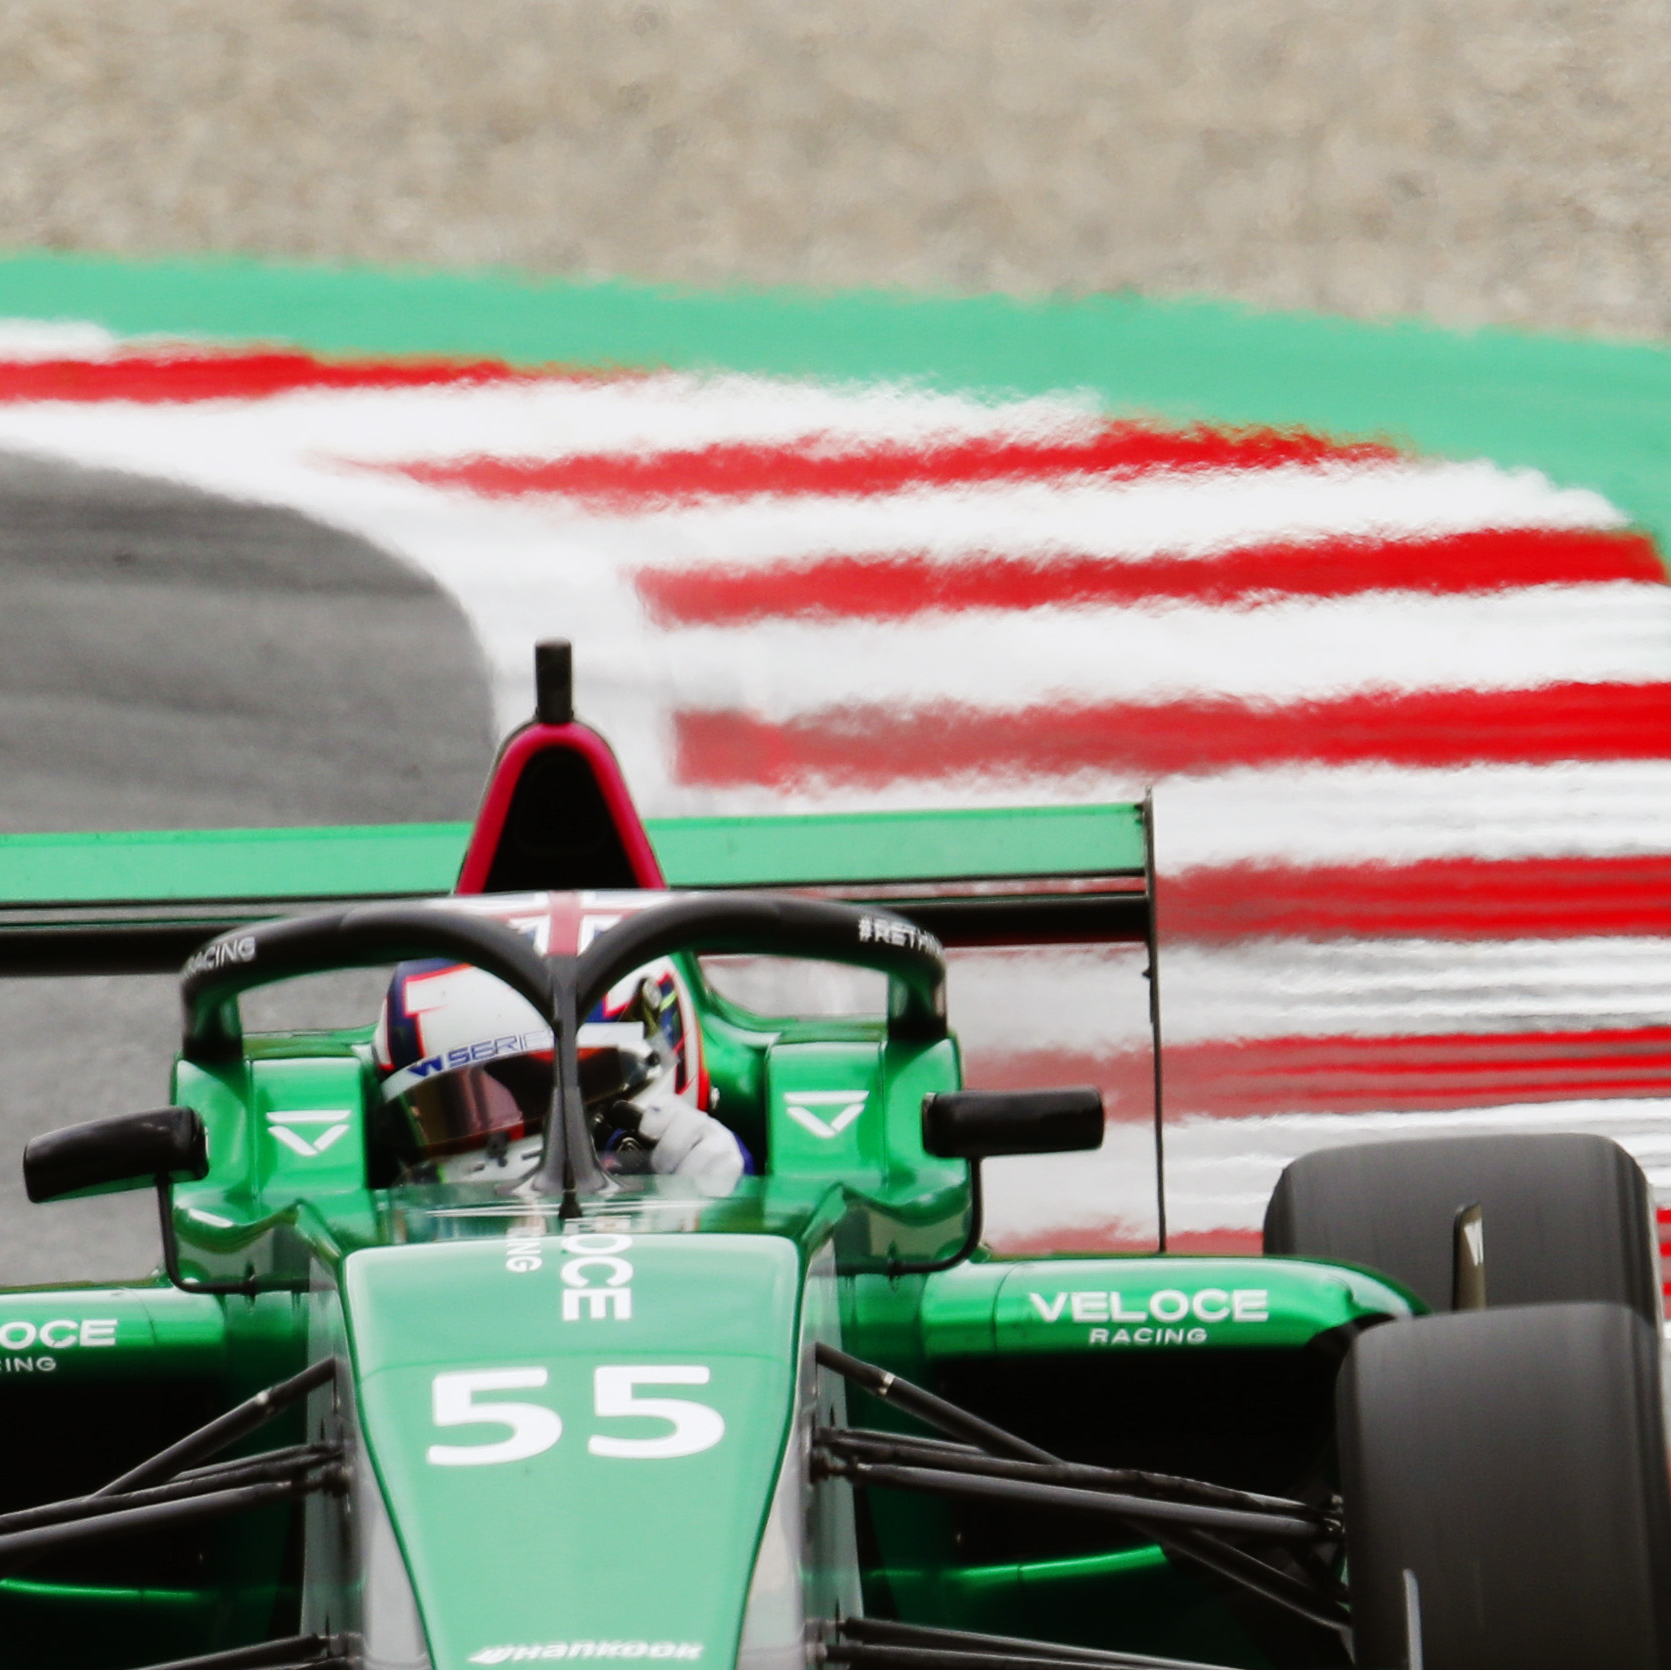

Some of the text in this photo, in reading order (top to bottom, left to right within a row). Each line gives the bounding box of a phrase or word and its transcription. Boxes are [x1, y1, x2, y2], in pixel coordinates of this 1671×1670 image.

[1029, 1288, 1270, 1323] VELOCE
[1088, 1327, 1208, 1346] RACING
[426, 1365, 726, 1466] 55
